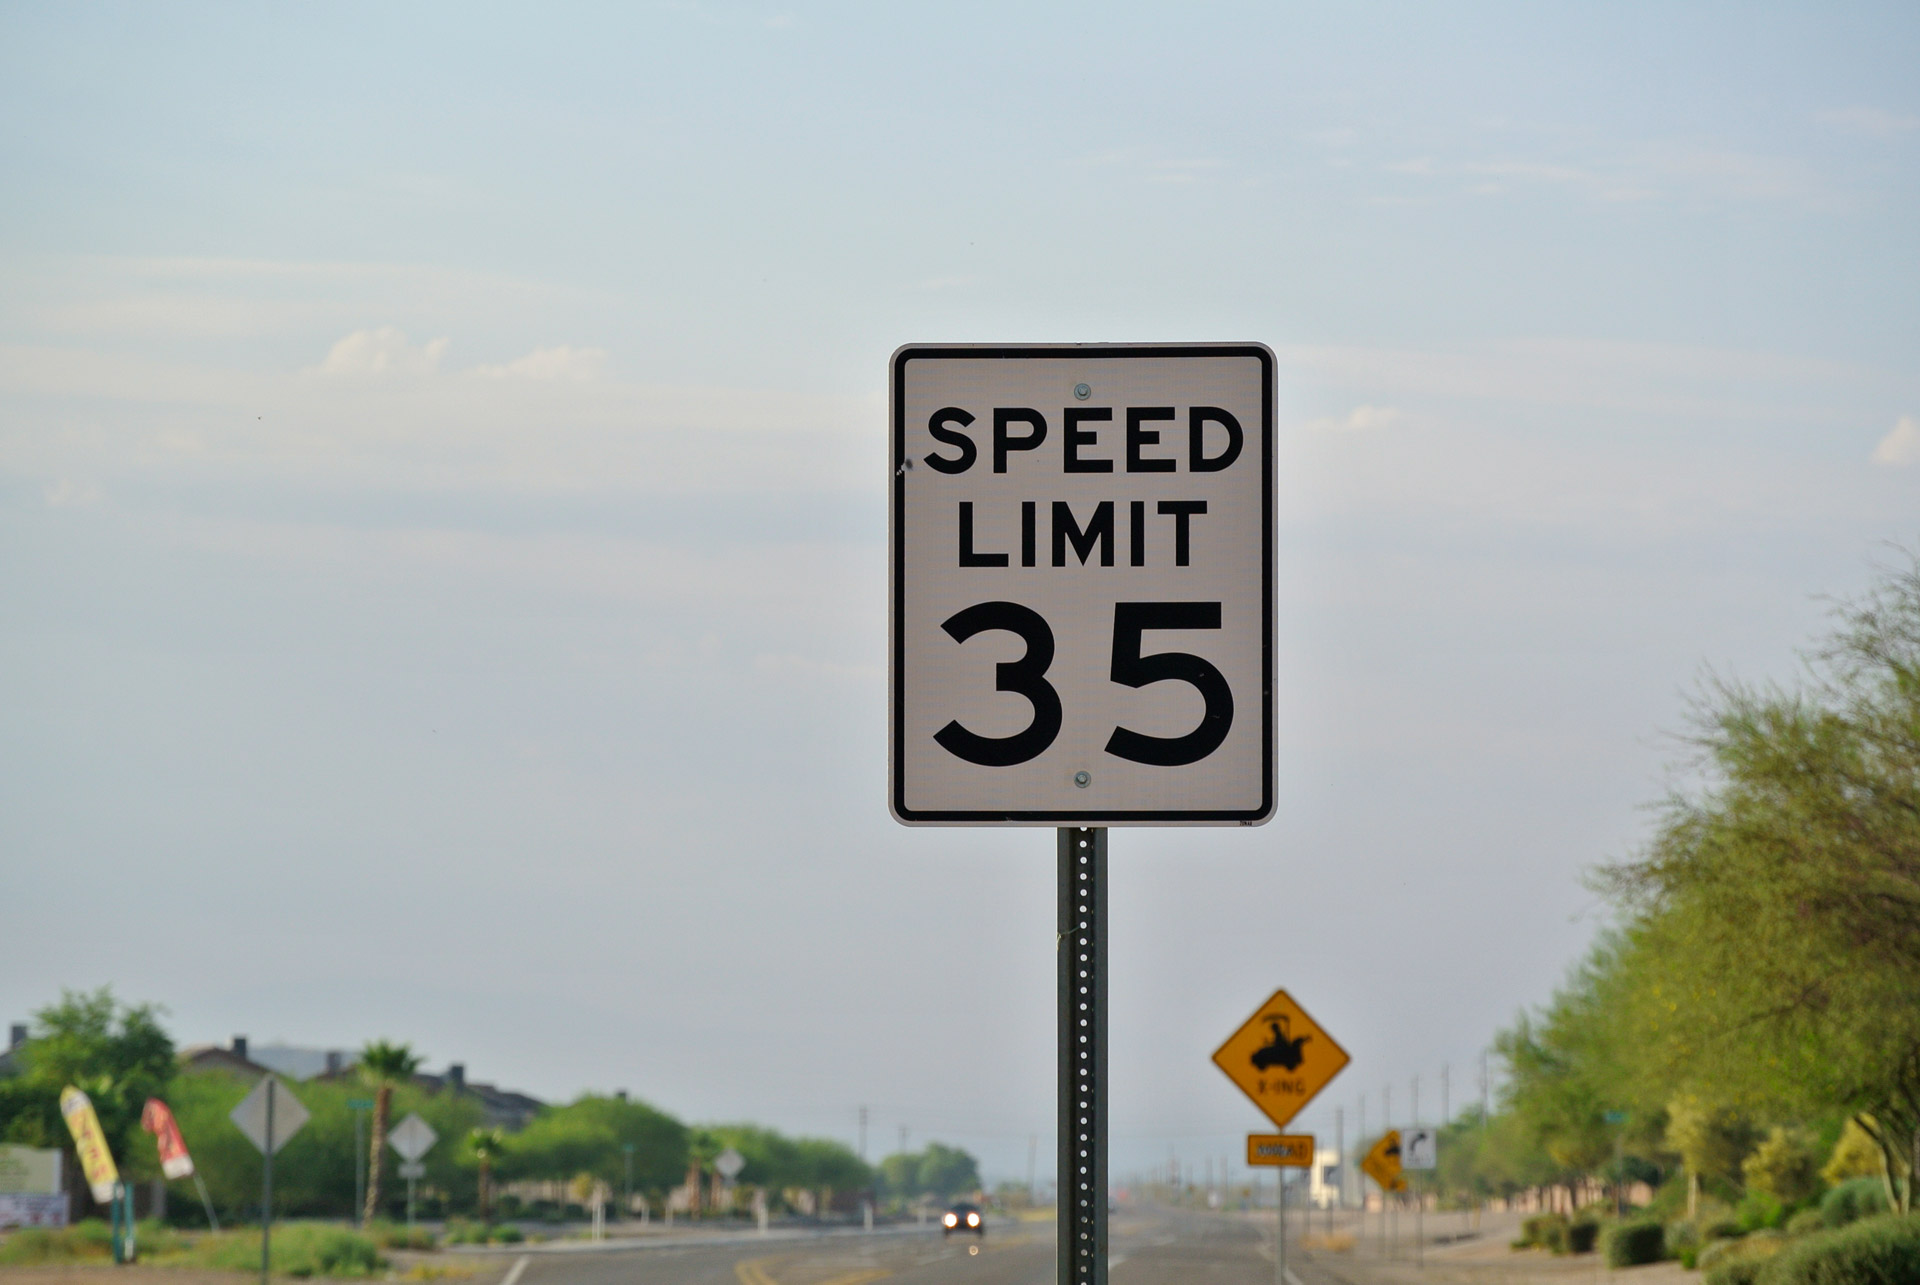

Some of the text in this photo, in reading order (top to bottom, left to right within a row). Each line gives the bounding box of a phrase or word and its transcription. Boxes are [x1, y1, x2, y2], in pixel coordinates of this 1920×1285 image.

[923, 406, 1244, 475] SPEED
[958, 500, 1208, 568] LIMIT
[932, 601, 1235, 768] 35
